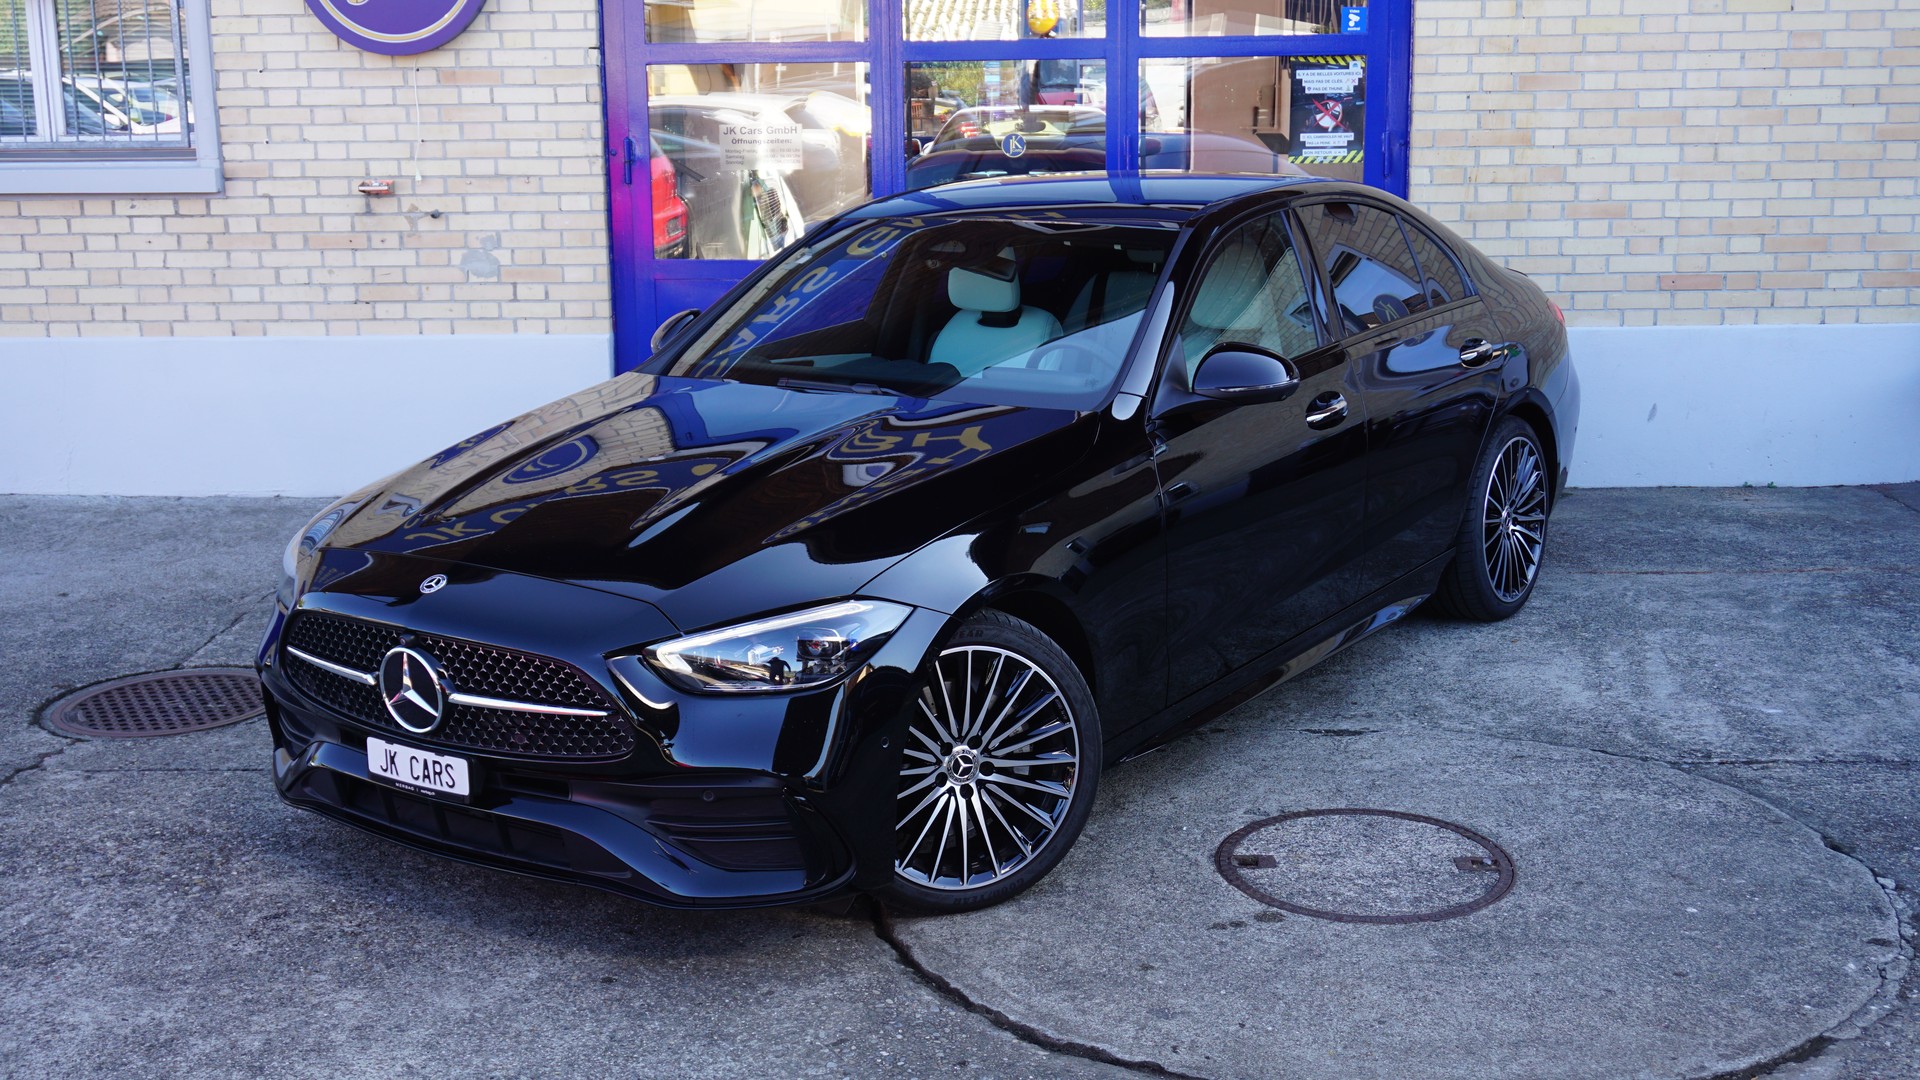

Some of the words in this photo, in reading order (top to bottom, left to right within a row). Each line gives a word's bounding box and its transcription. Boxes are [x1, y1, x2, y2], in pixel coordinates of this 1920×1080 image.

[723, 126, 737, 136] JK
[739, 126, 763, 135] Cars
[766, 126, 798, 135] GmbH
[380, 748, 399, 777] JK
[409, 755, 456, 789] CARS
